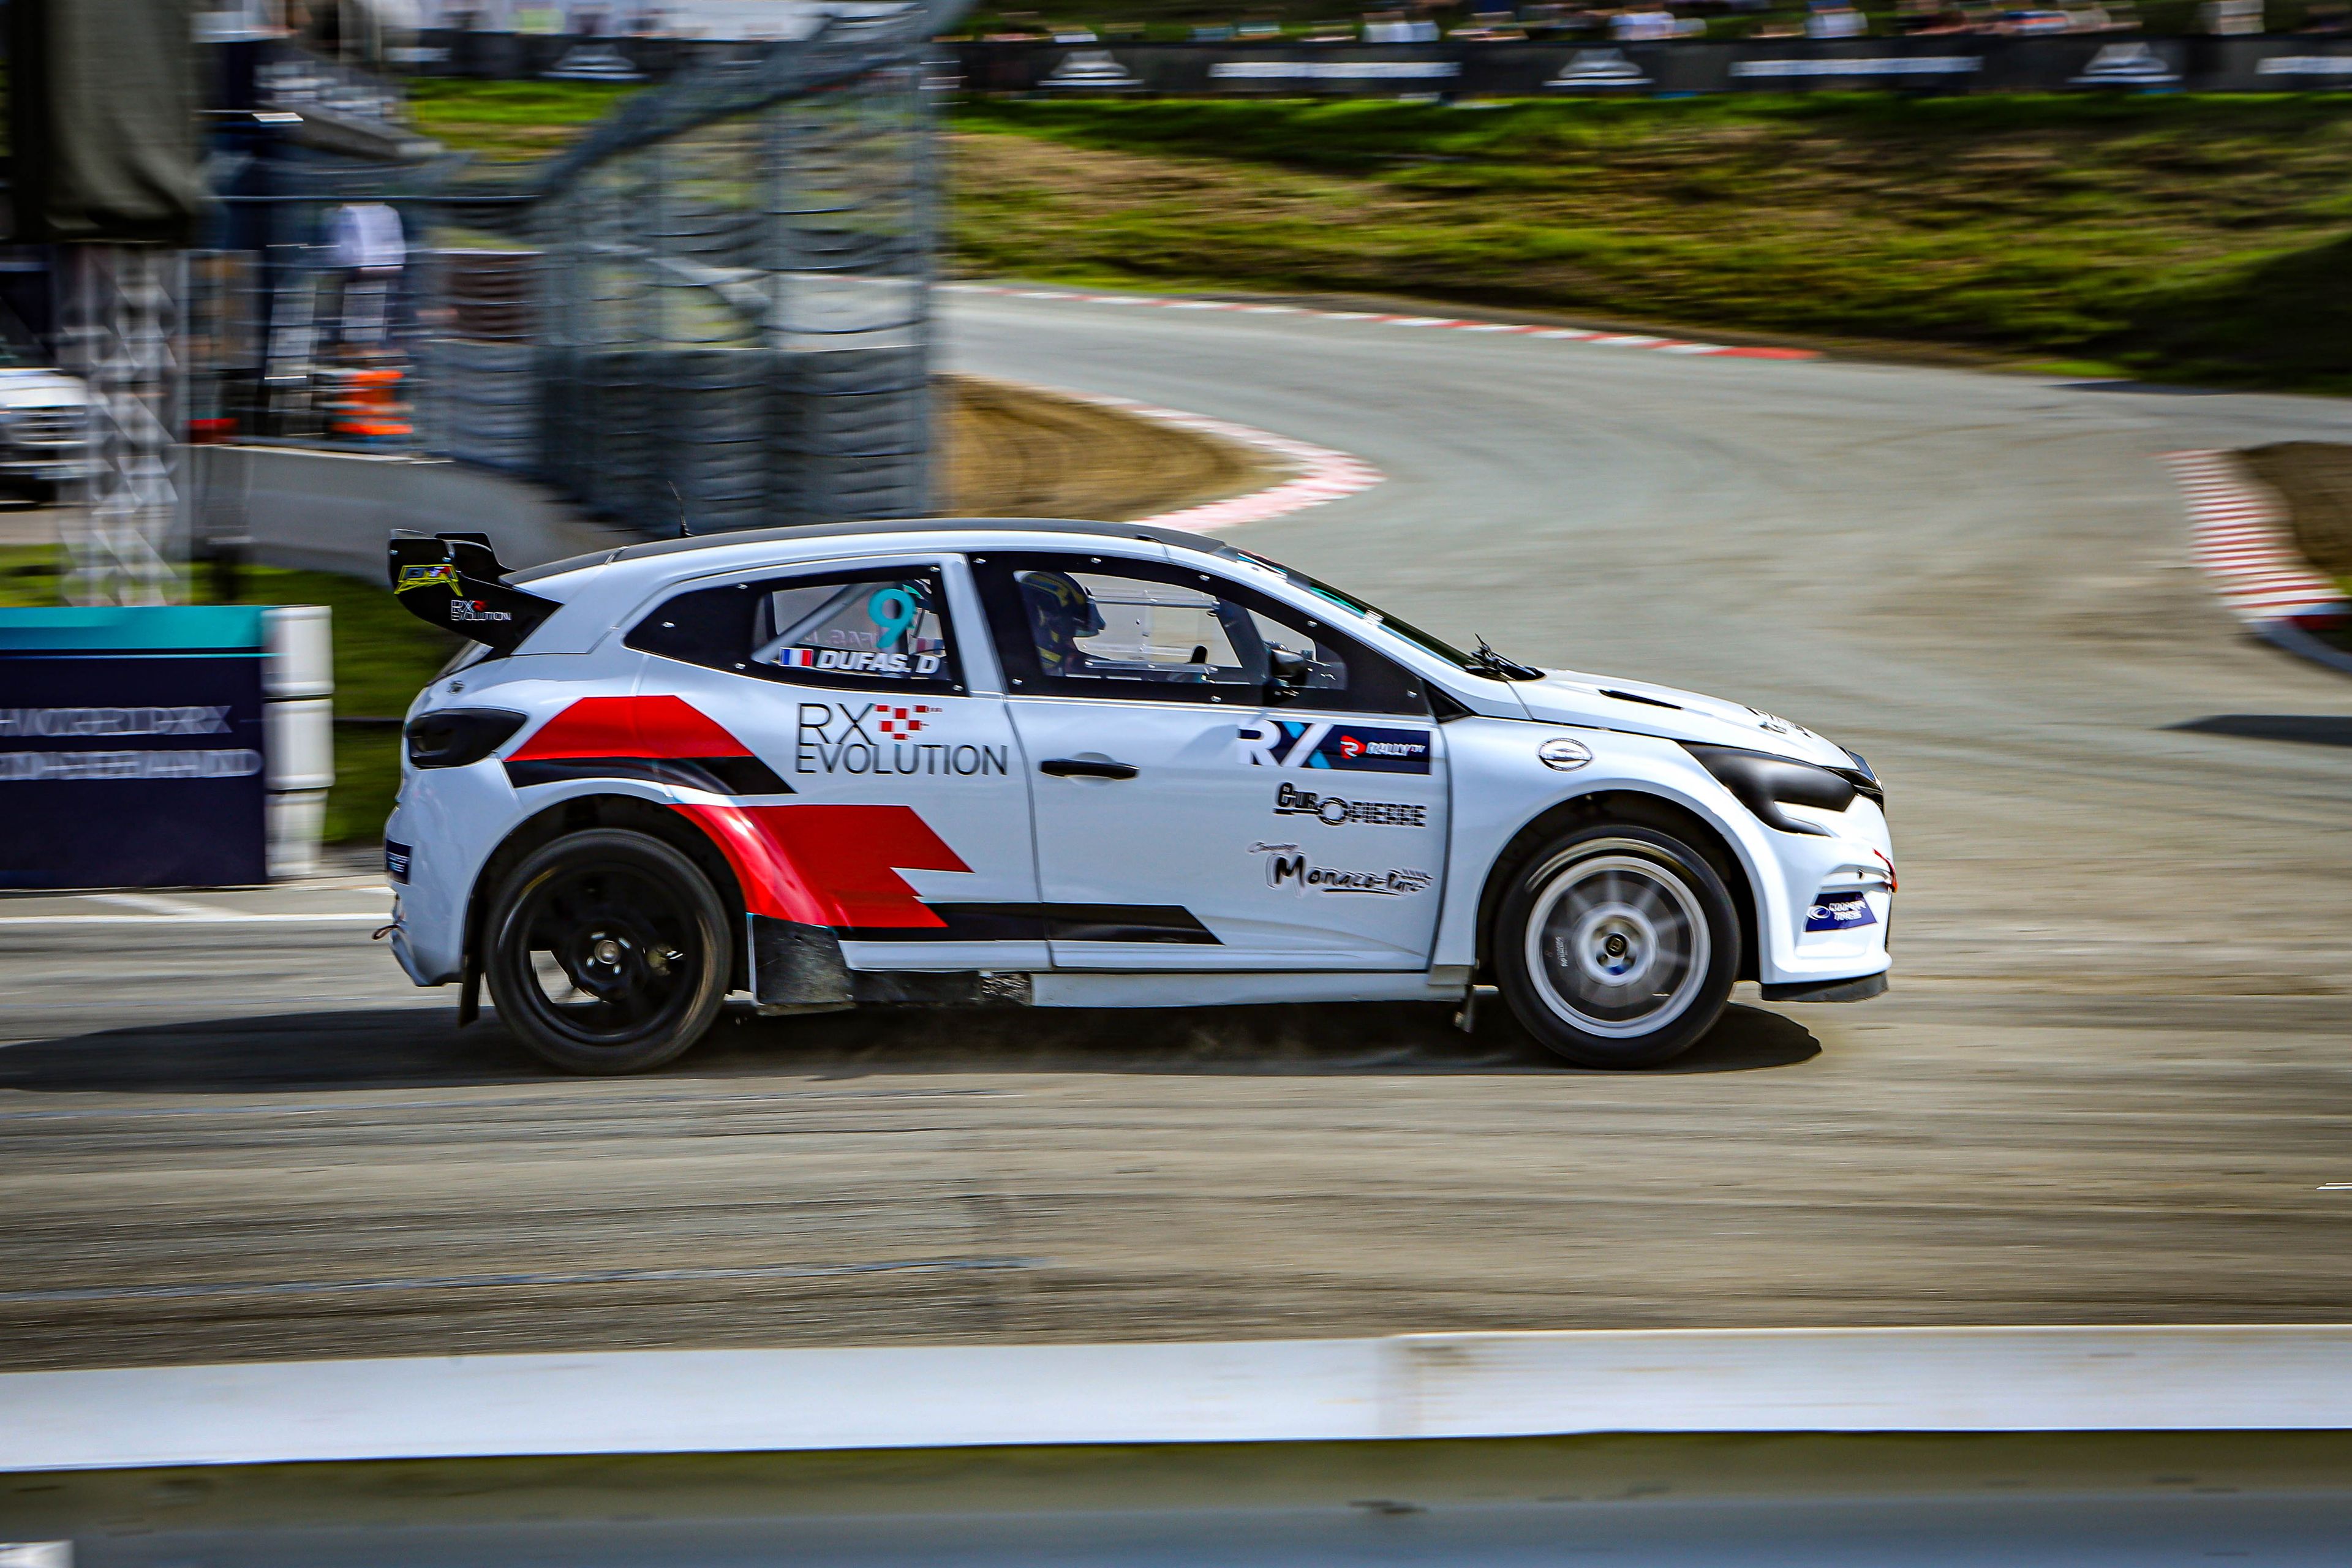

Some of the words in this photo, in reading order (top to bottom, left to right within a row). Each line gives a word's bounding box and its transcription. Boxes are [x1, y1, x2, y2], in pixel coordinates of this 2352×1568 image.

[451, 600, 475, 612] RX
[451, 611, 511, 620] EVOLUTION
[868, 588, 916, 648] 9
[915, 654, 940, 674] D
[797, 702, 875, 744] RX
[796, 742, 1008, 775] EVOLUTION
[1237, 719, 1334, 769] RX
